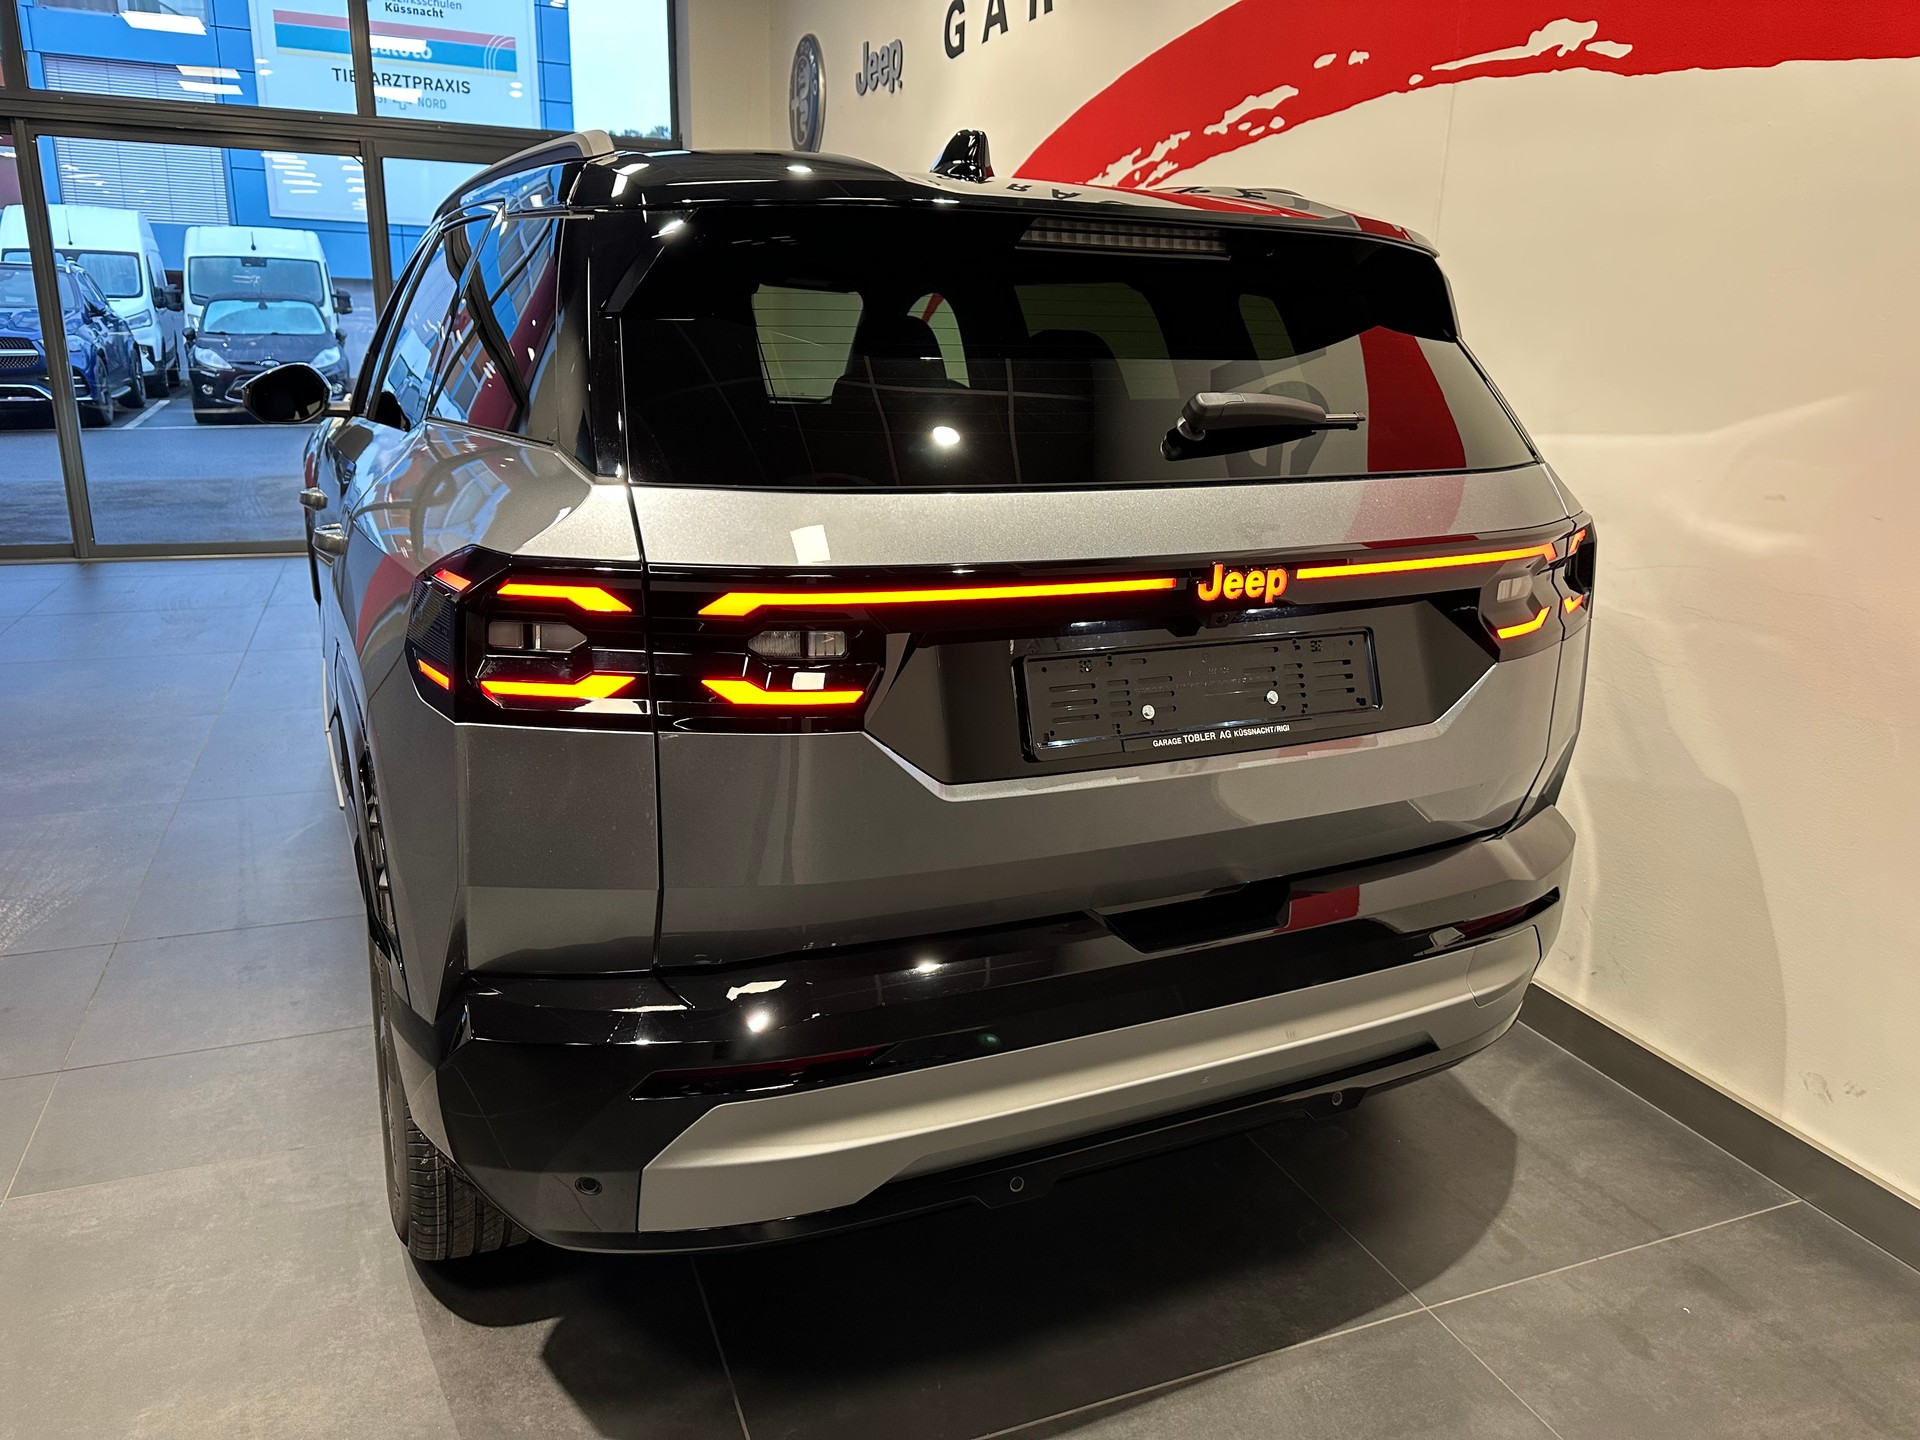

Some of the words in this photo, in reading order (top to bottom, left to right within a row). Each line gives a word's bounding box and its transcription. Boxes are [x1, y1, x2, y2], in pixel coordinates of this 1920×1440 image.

[385, 2, 444, 18] Küssnacht
[331, 67, 471, 94] TIEARZTPRAXIS
[856, 39, 903, 96] Jeep
[1198, 563, 1288, 604] Jeep
[1152, 737, 1182, 748] GARAGE
[1183, 731, 1217, 744] TOBLER
[1219, 729, 1232, 740] AG
